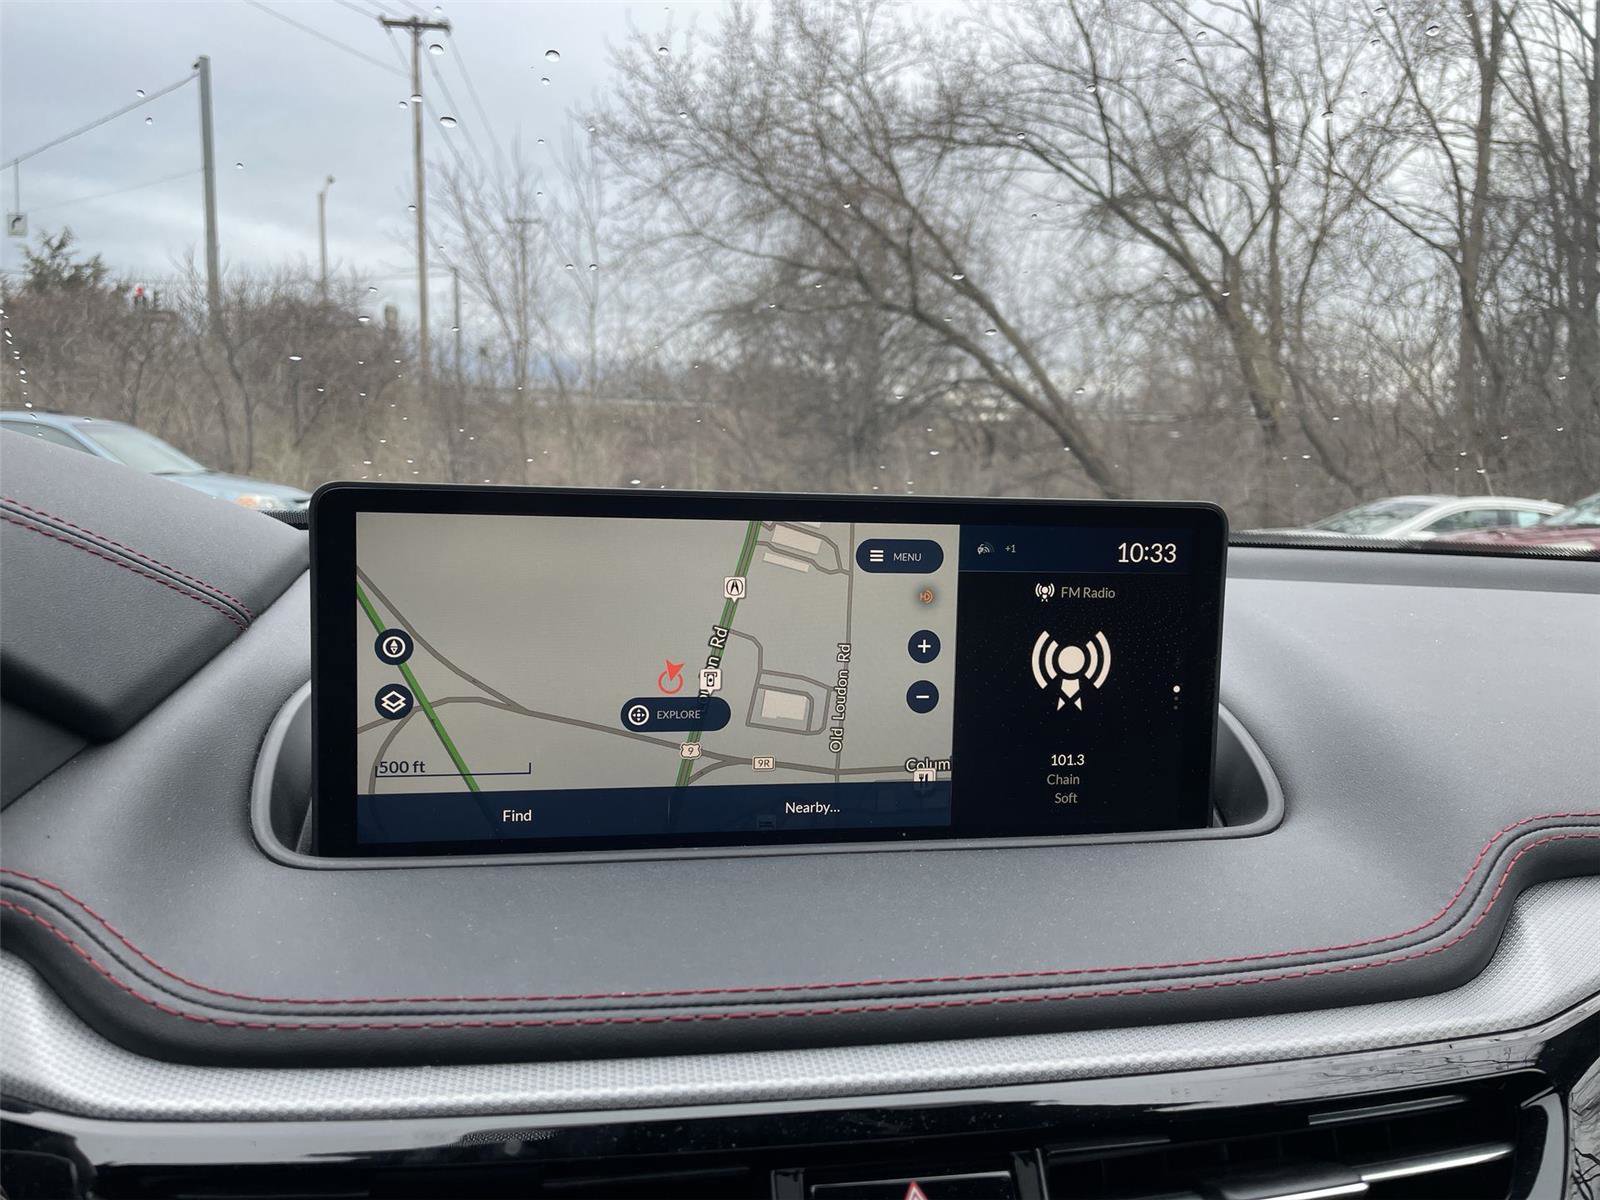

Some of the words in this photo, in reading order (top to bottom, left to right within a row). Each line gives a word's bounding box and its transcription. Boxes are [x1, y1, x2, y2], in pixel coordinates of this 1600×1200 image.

[1004, 544, 1017, 553] +1
[1117, 542, 1177, 564] 10:33
[893, 552, 922, 562] MENU
[1060, 586, 1082, 599] FM
[1083, 586, 1116, 600] Radio
[709, 625, 729, 650] Rd
[837, 643, 852, 663] Rd
[832, 669, 850, 721] Loudon
[656, 709, 701, 720] EXPLORE
[828, 727, 844, 754] Old
[687, 746, 694, 755] 9
[378, 760, 410, 774] 500
[412, 760, 426, 774] ft
[757, 759, 770, 768] 9R
[905, 756, 951, 772] Colum
[1050, 753, 1085, 767] 101.3
[1046, 773, 1081, 786] Chain
[1054, 791, 1078, 805] Soft
[784, 801, 841, 816] Nearby...
[502, 809, 533, 823] Find
